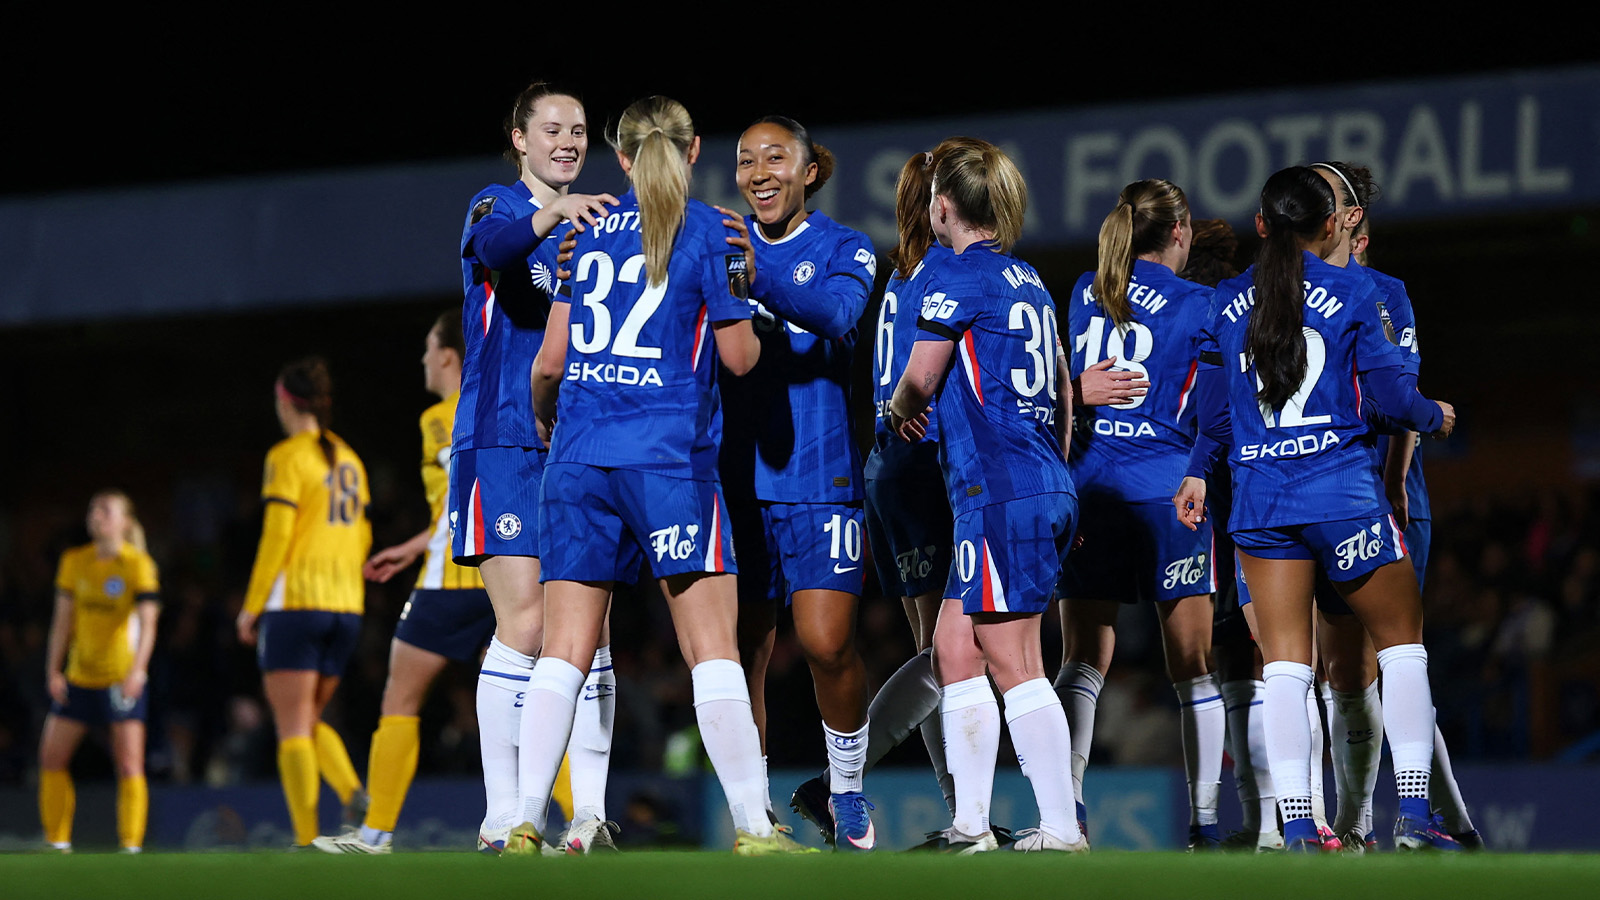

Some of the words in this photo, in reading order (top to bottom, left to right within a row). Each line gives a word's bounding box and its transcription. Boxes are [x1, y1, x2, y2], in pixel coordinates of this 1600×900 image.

[1064, 94, 1573, 229] FOOTBALL
[593, 211, 643, 239] POTT
[571, 250, 669, 360] 32
[1083, 281, 1169, 315] KTEIN
[1008, 301, 1058, 401] 30
[1076, 316, 1154, 410] 18
[1093, 418, 1157, 438] ODA
[325, 463, 360, 526] 18
[649, 524, 696, 563] Flo
[823, 514, 861, 563] 10
[1334, 528, 1384, 571] Flo
[896, 547, 933, 583] Flo
[1163, 555, 1205, 590] Flo
